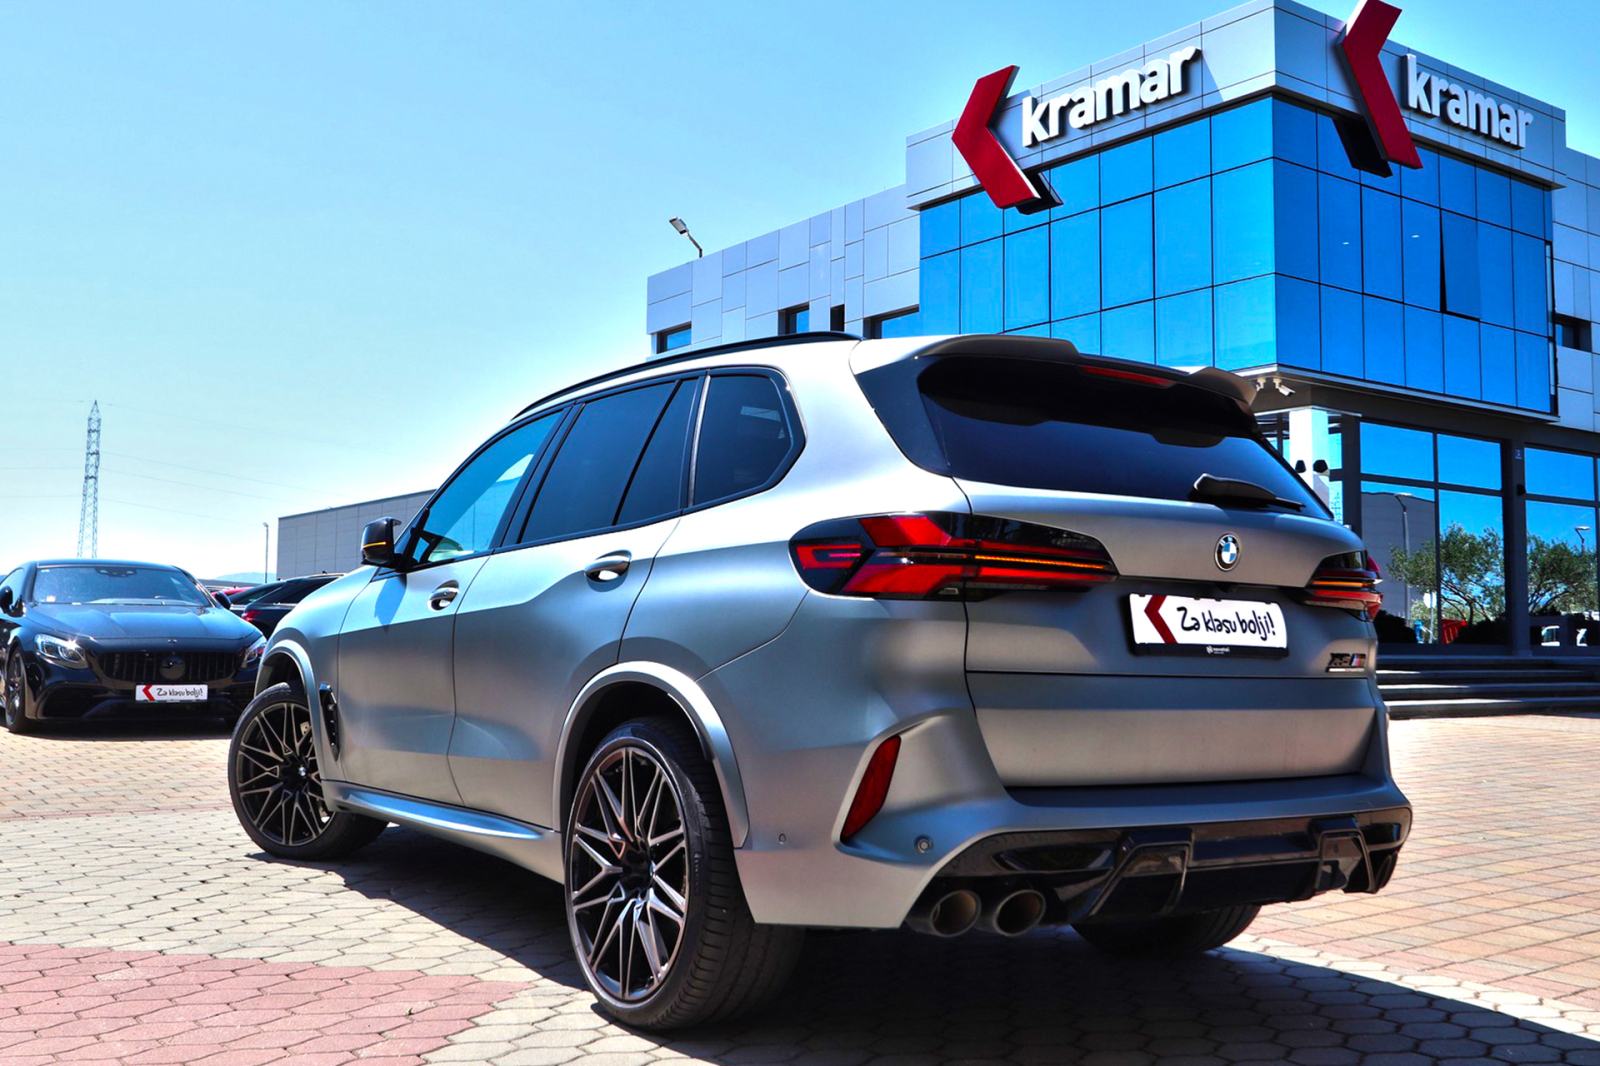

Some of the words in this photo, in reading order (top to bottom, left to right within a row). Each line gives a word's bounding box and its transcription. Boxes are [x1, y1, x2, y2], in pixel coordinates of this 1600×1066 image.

[1022, 46, 1198, 147] kramar
[1405, 53, 1534, 148] kramar
[1176, 606, 1200, 631] Za
[1201, 609, 1237, 634] klasu
[1235, 609, 1276, 641] bolji!
